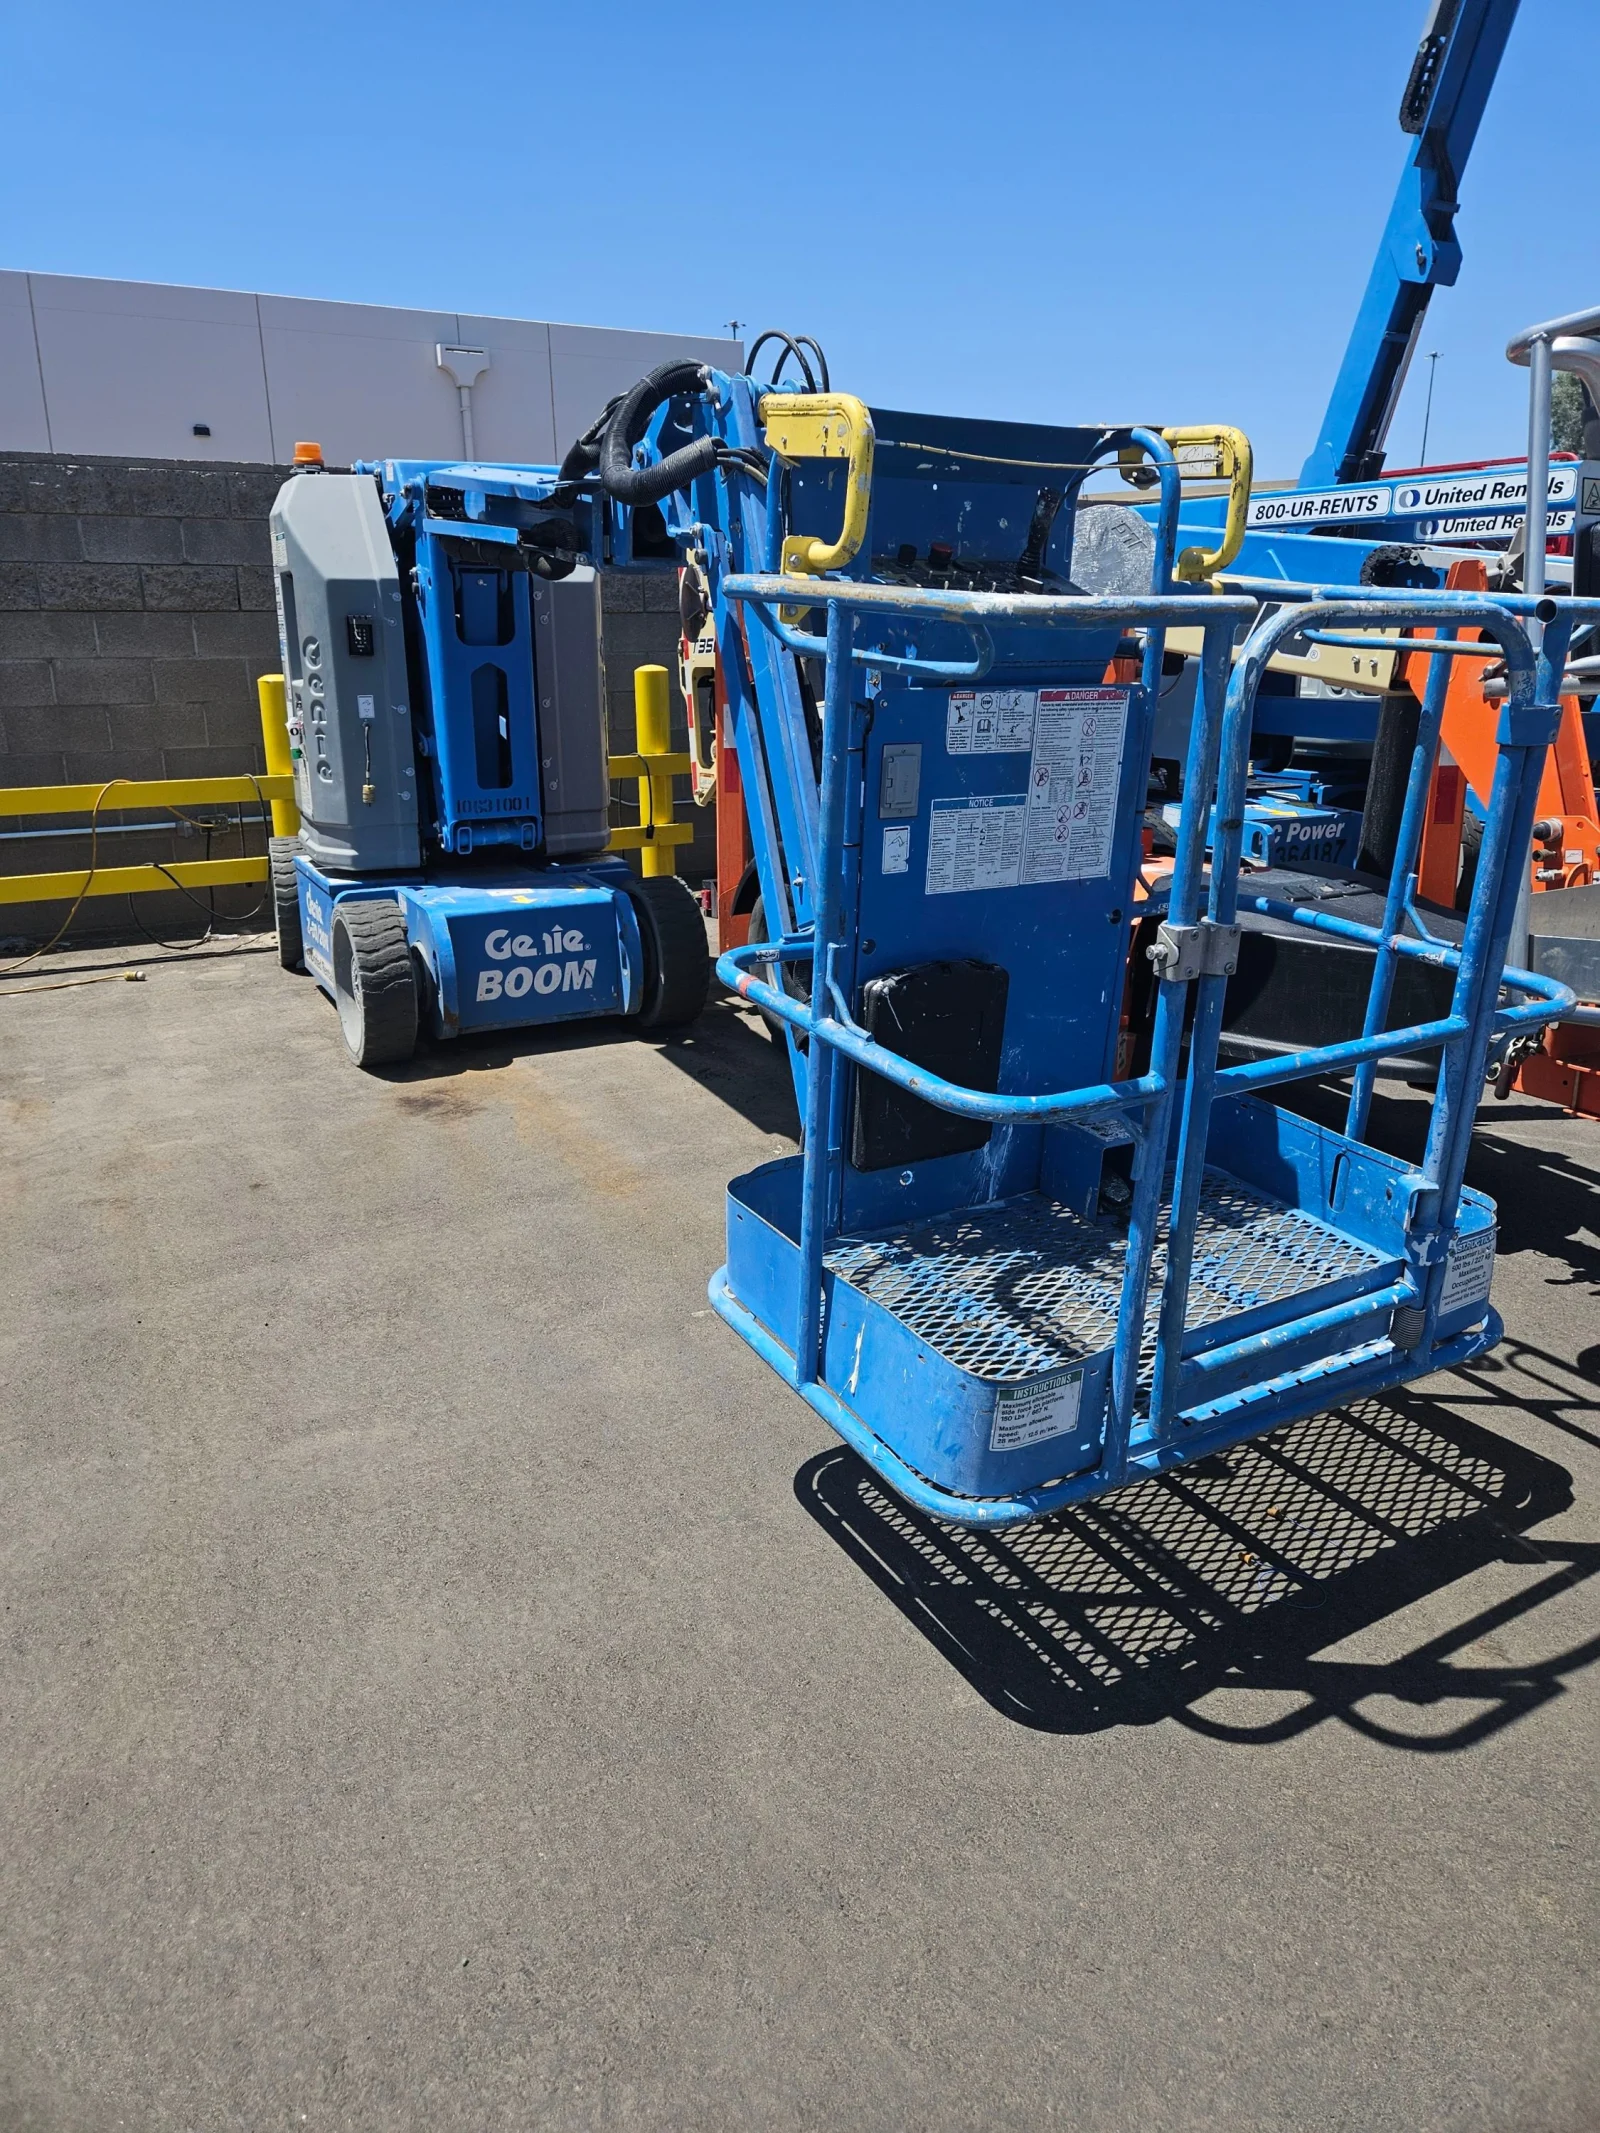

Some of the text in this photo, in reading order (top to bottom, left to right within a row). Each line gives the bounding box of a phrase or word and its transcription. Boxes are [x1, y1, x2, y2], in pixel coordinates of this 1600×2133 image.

[1425, 477, 1565, 505] United Renls
[1255, 495, 1379, 520] 800-UR-RENTS
[1443, 512, 1567, 534] United Reals
[1071, 691, 1099, 700] DANGER
[969, 799, 994, 808] NOTICE
[1286, 821, 1345, 843] Power
[484, 924, 585, 960] Genie
[476, 959, 597, 1002] BOOM
[1458, 1265, 1484, 1278] Maximum
[1013, 1374, 1072, 1400] INSTRUCTIONS
[1002, 1392, 1056, 1409] Maximum allowable
[1017, 1405, 1032, 1414] force
[998, 1415, 1053, 1431] Maximum allowable
[998, 1430, 1019, 1438] speed:
[1028, 1430, 1039, 1438] 12.5
